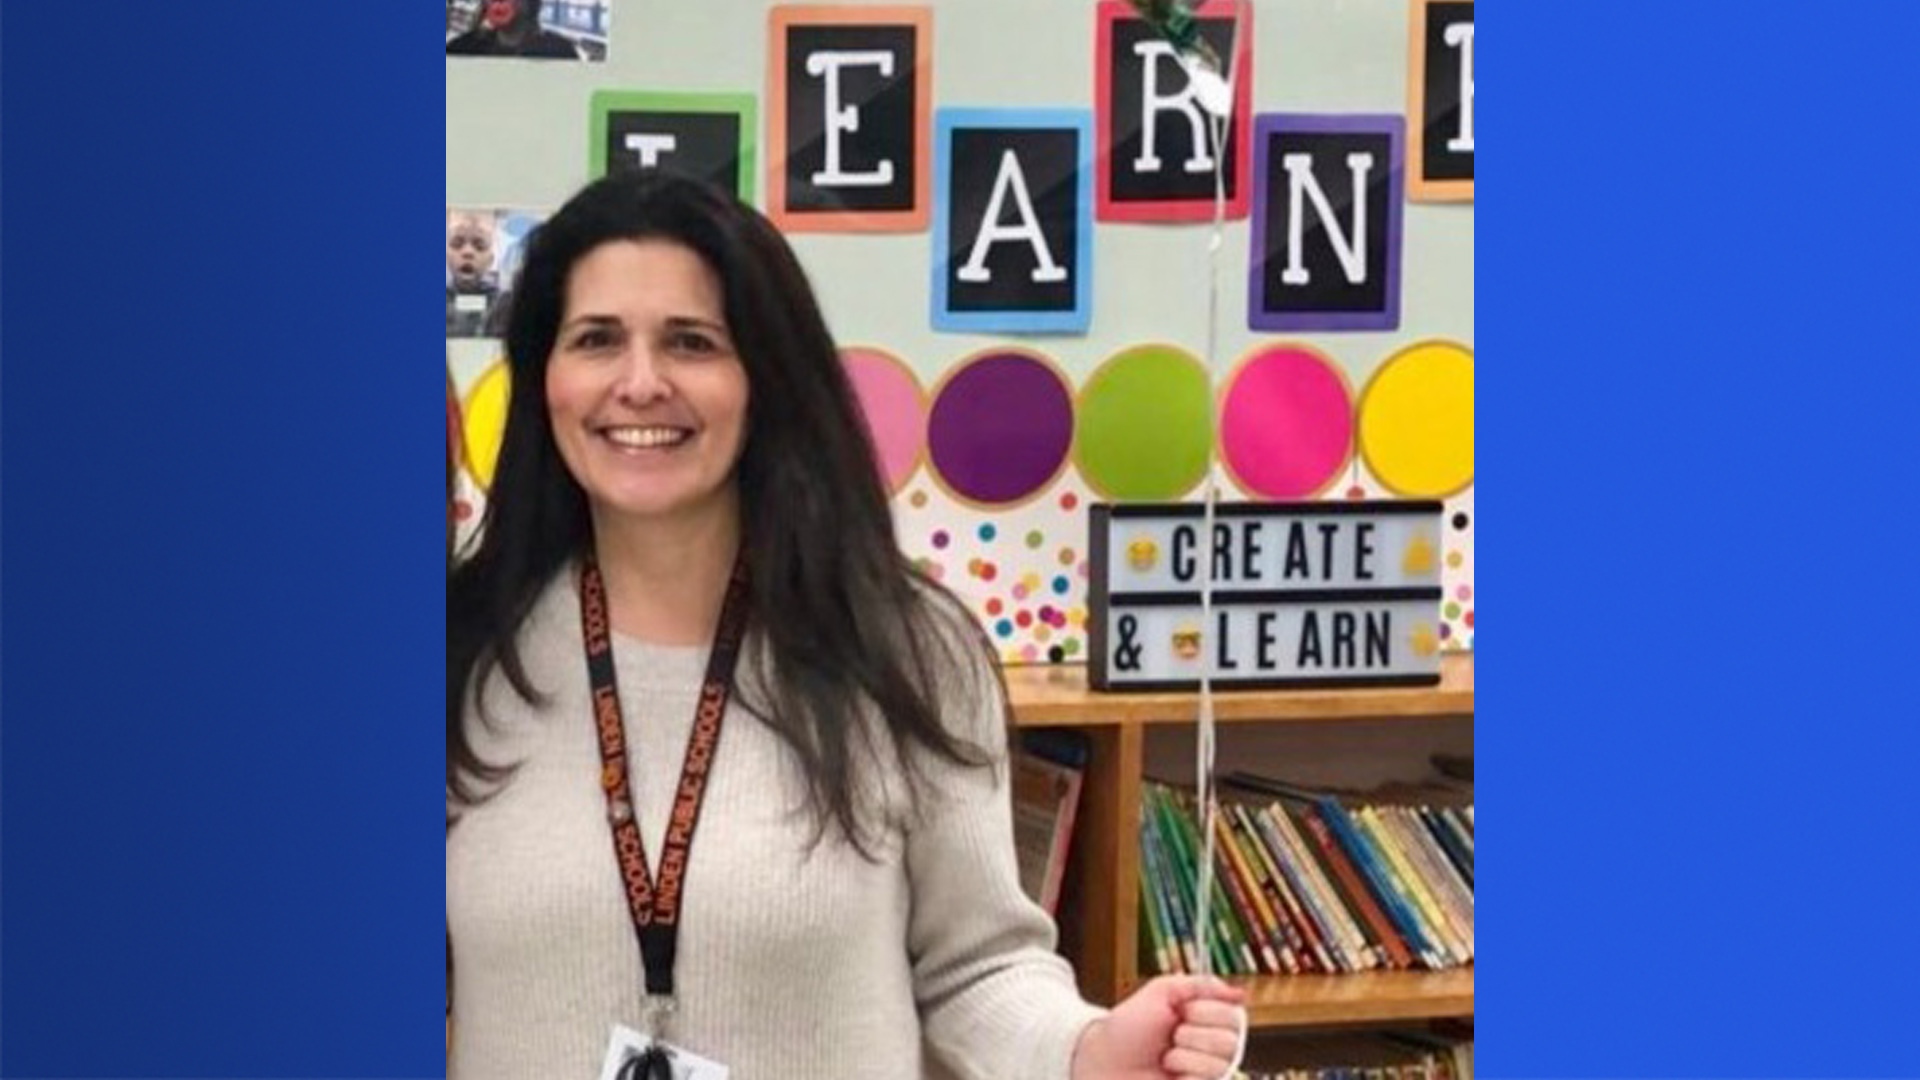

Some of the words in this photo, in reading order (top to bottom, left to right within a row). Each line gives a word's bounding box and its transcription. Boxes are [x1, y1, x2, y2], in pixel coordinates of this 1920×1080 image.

[625, 40, 1373, 285] EARN
[1171, 521, 1374, 582] CREATE
[1114, 613, 1143, 672] &
[1217, 610, 1391, 669] LEARN
[685, 683, 725, 773] SCHOOLS
[668, 776, 704, 844] PUBLIC
[617, 824, 652, 926] SCHOOLS
[654, 847, 685, 925] LINDEN
